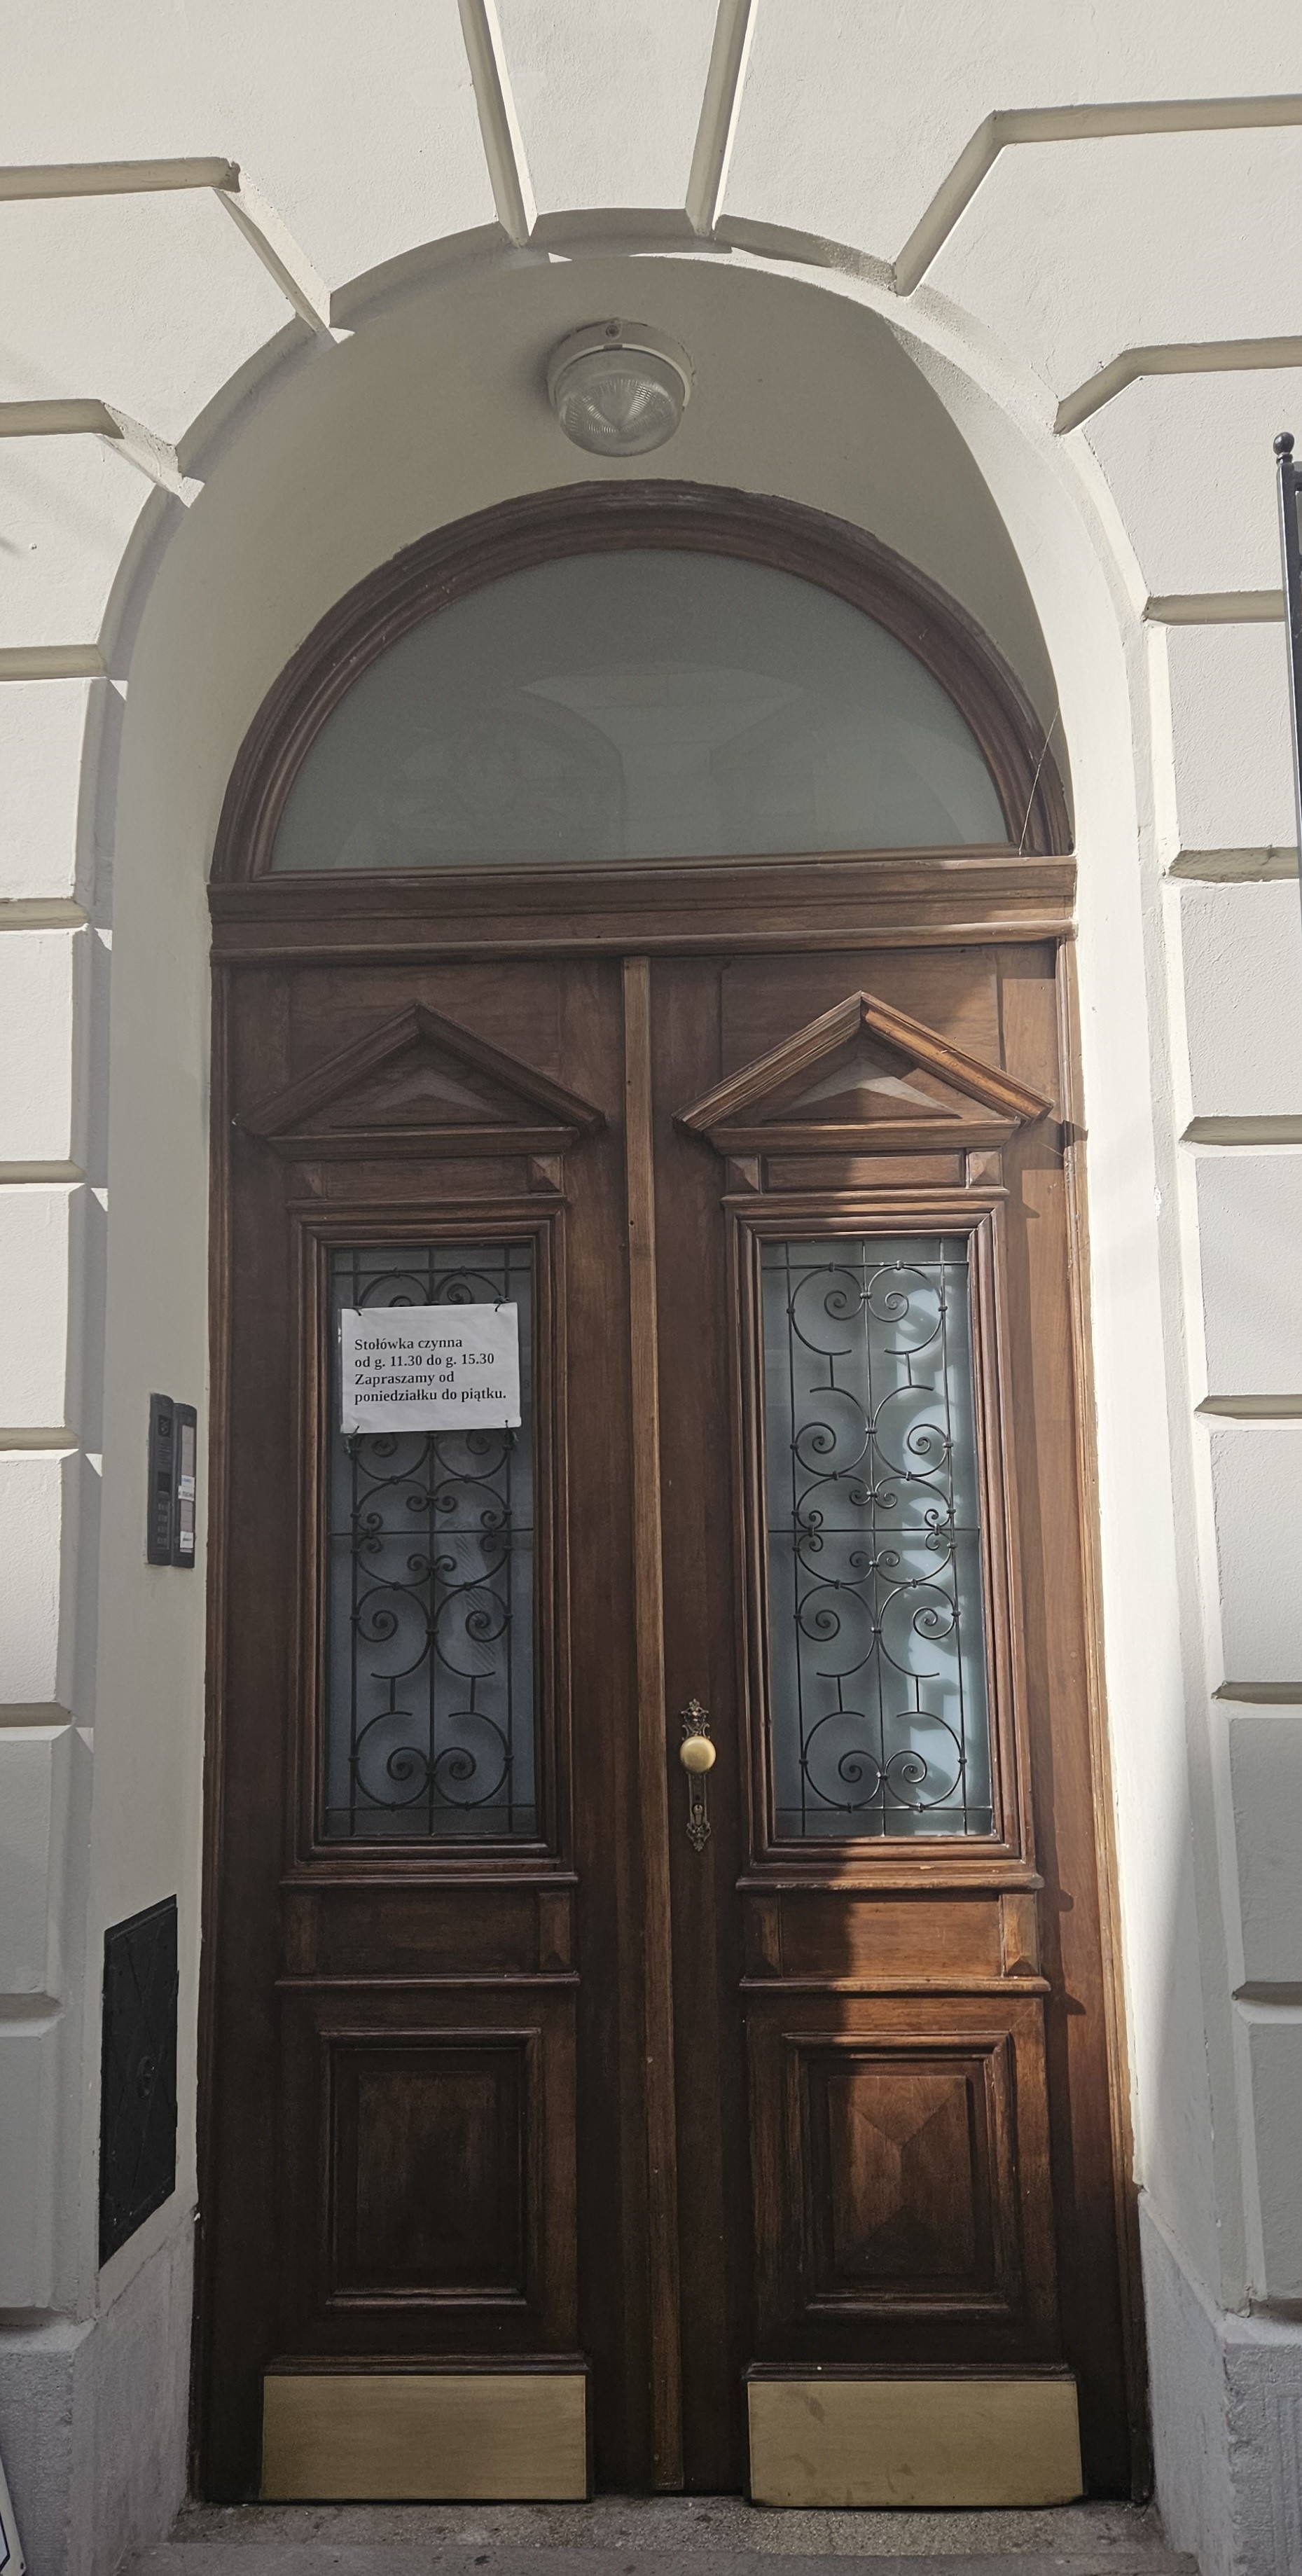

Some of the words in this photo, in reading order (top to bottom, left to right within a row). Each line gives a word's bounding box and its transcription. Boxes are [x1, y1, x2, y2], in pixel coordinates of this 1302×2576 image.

[354, 1337, 414, 1350] Stołówka
[417, 1340, 462, 1352] czynna
[354, 1355, 370, 1368] od
[374, 1359, 386, 1371] g.
[390, 1355, 422, 1367] 11.30
[427, 1354, 442, 1366] do
[445, 1357, 457, 1369] g.
[462, 1352, 494, 1365] 15.30
[354, 1373, 435, 1388] Zapraszamy
[438, 1371, 455, 1383] od
[354, 1389, 437, 1406] poniedziałku
[441, 1388, 457, 1400] do
[461, 1387, 506, 1403] piątku.
